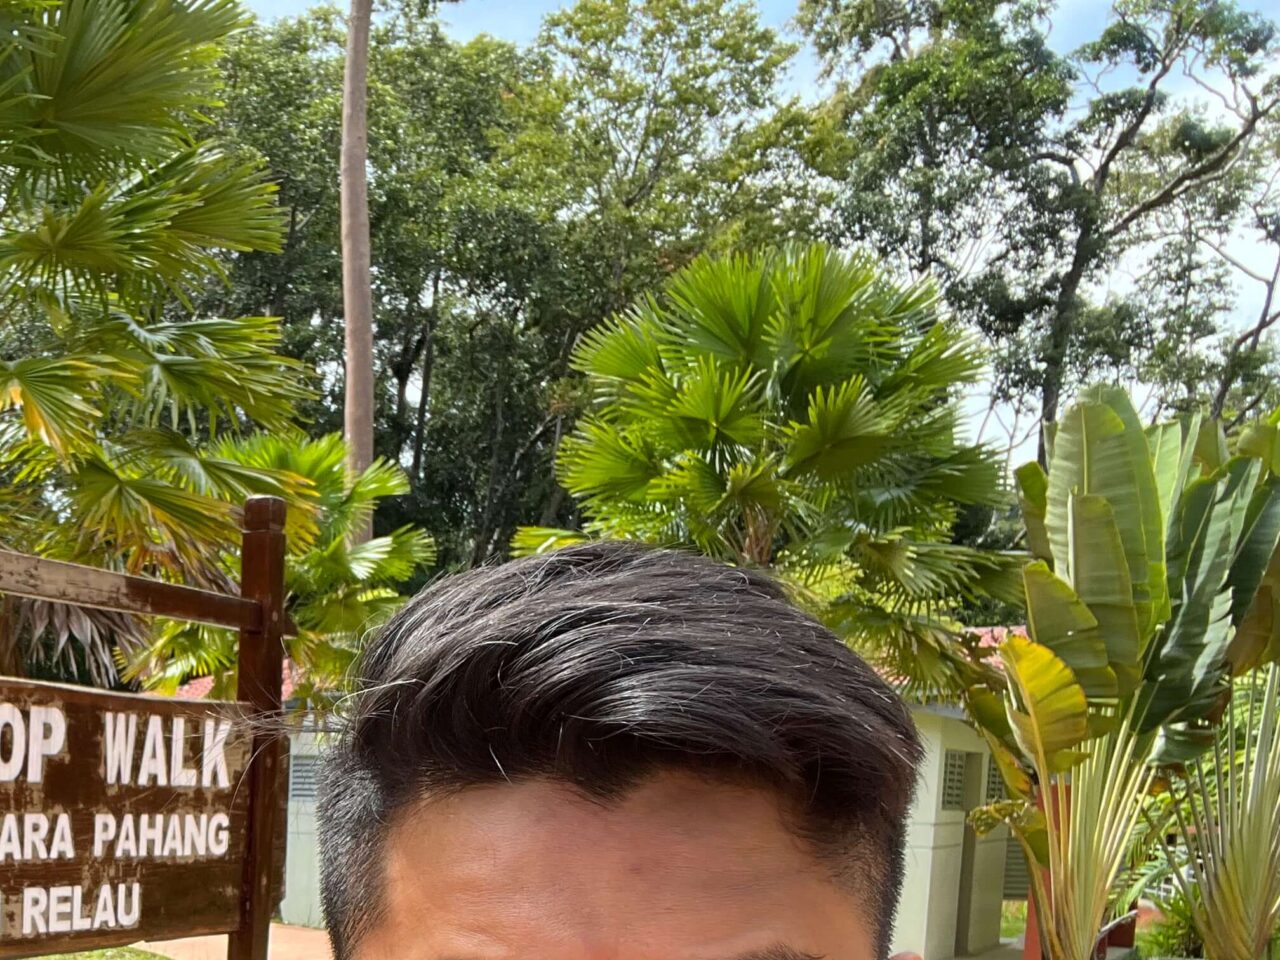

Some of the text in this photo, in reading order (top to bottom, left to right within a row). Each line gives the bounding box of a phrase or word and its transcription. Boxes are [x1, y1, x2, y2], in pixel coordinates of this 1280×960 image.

[105, 712, 232, 788] WALK
[94, 813, 229, 857] PAHANG
[22, 882, 140, 934] RELAU
